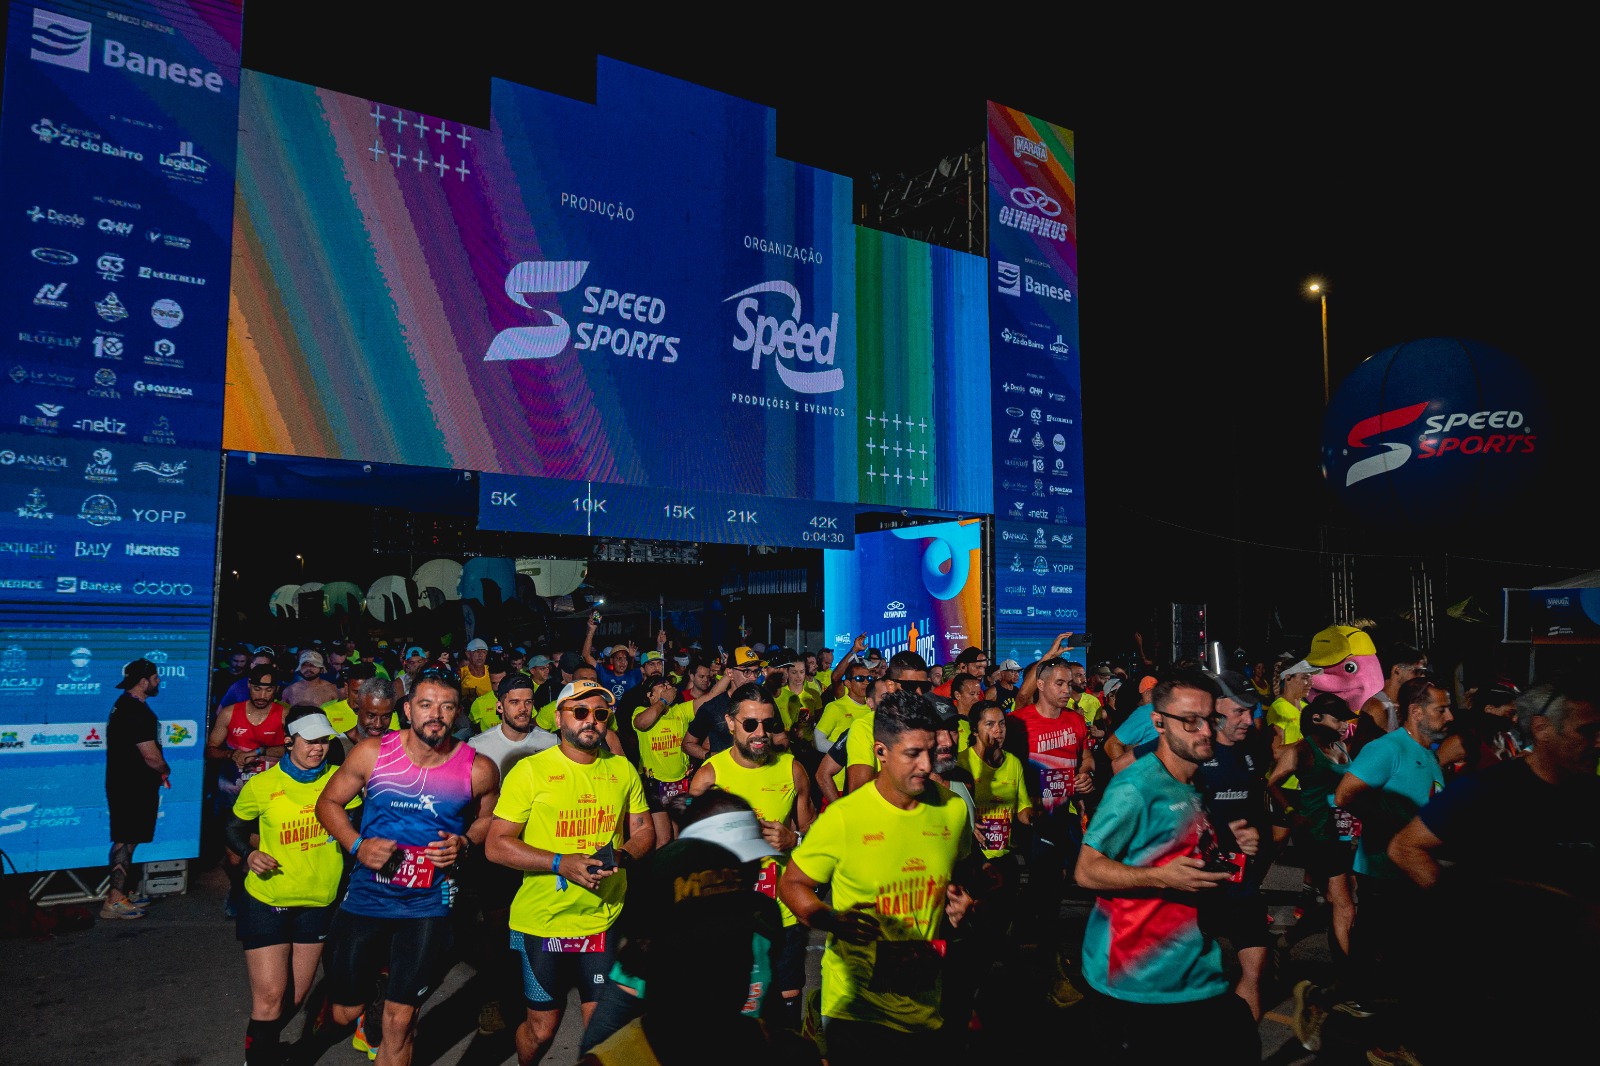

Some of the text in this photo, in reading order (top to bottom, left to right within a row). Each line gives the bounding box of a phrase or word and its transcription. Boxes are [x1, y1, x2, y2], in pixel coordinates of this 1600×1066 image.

[103, 39, 224, 93] Banese
[80, 138, 100, 153] do
[102, 142, 144, 162] Bairro
[159, 153, 208, 174] Legislar
[560, 191, 636, 222] PRODUÇÃO
[999, 205, 1068, 242] OLYMPIKUS
[743, 234, 824, 267] ORGANIZAÇÃO
[1025, 275, 1072, 303] Banese
[583, 286, 666, 324] SPEED
[574, 323, 680, 363] SPORTS
[732, 298, 839, 370] Speed
[731, 393, 845, 417] PRODUÇÕES E EVENTOS
[81, 416, 127, 435] netiz
[1424, 410, 1524, 435] SPEED
[1417, 434, 1537, 460] SPORTS
[132, 508, 187, 524] YOPP
[490, 491, 838, 530] 5K 10K 15K 21K 42K
[802, 530, 845, 544] 0:04:30
[74, 541, 113, 558] BALY
[1052, 564, 1074, 573] YOPP
[80, 581, 193, 596] Banese dobro
[1214, 788, 1249, 800] minas
[280, 823, 319, 846] ARACAJU
[556, 817, 597, 837] ARACAJU
